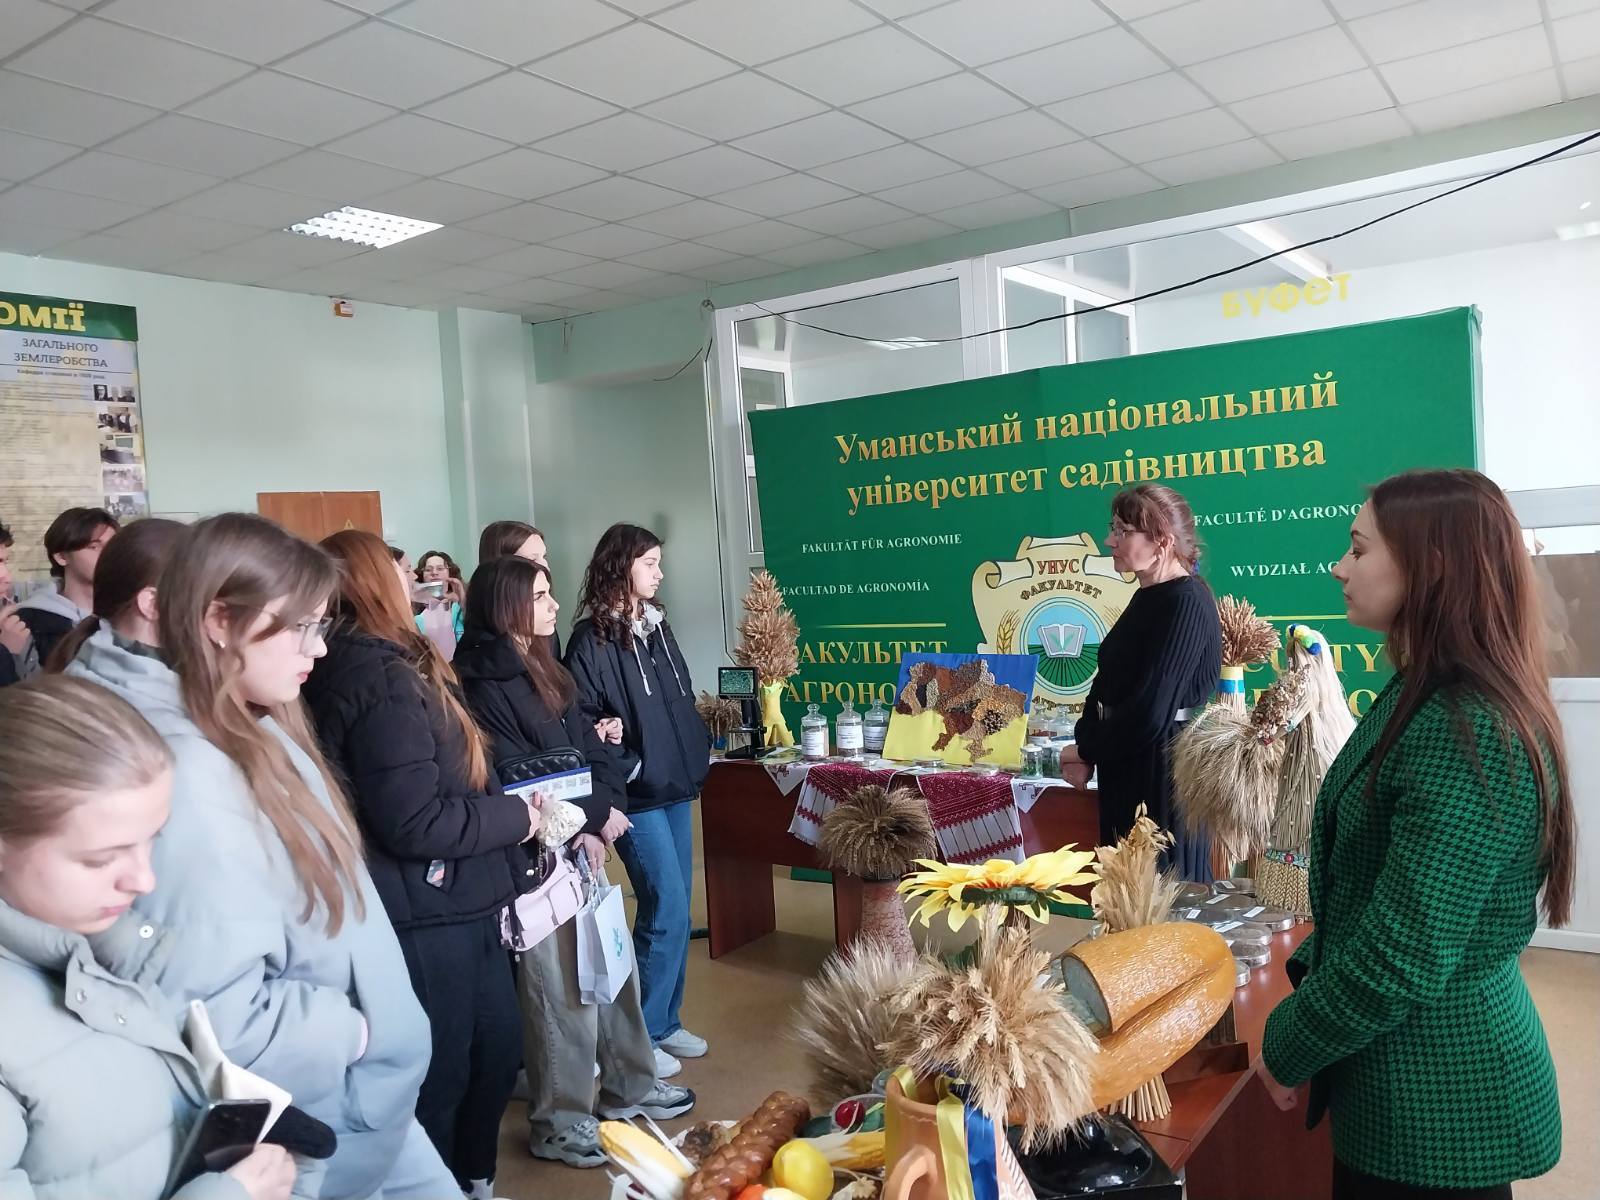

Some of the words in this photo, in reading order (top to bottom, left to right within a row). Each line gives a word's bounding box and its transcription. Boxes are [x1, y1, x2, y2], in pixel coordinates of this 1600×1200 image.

[22, 338, 98, 352] ЗАГАЛЬНОГО
[14, 353, 108, 367] ЗЕМЛЕРОБСТВА
[834, 412, 1023, 464] Уманський
[1035, 371, 1339, 440] національний
[847, 475, 1048, 516] університет
[1059, 439, 1327, 489] садівництва
[1194, 507, 1267, 526] FACULTÉ
[1272, 503, 1362, 521] D'AGRONO
[802, 539, 859, 554] FAKULTÄT
[861, 538, 884, 550] FÜR
[886, 533, 962, 548] AGRONOMIE
[1037, 559, 1080, 575] УНУС
[1230, 562, 1311, 577] WYDZIAŁ
[783, 584, 837, 596] FACULTAD
[839, 584, 854, 594] DE
[856, 579, 930, 594] AGRONOMÍA
[1020, 579, 1102, 600] ФАКУЛЬТЕТ
[786, 681, 897, 706] АГРОНО
